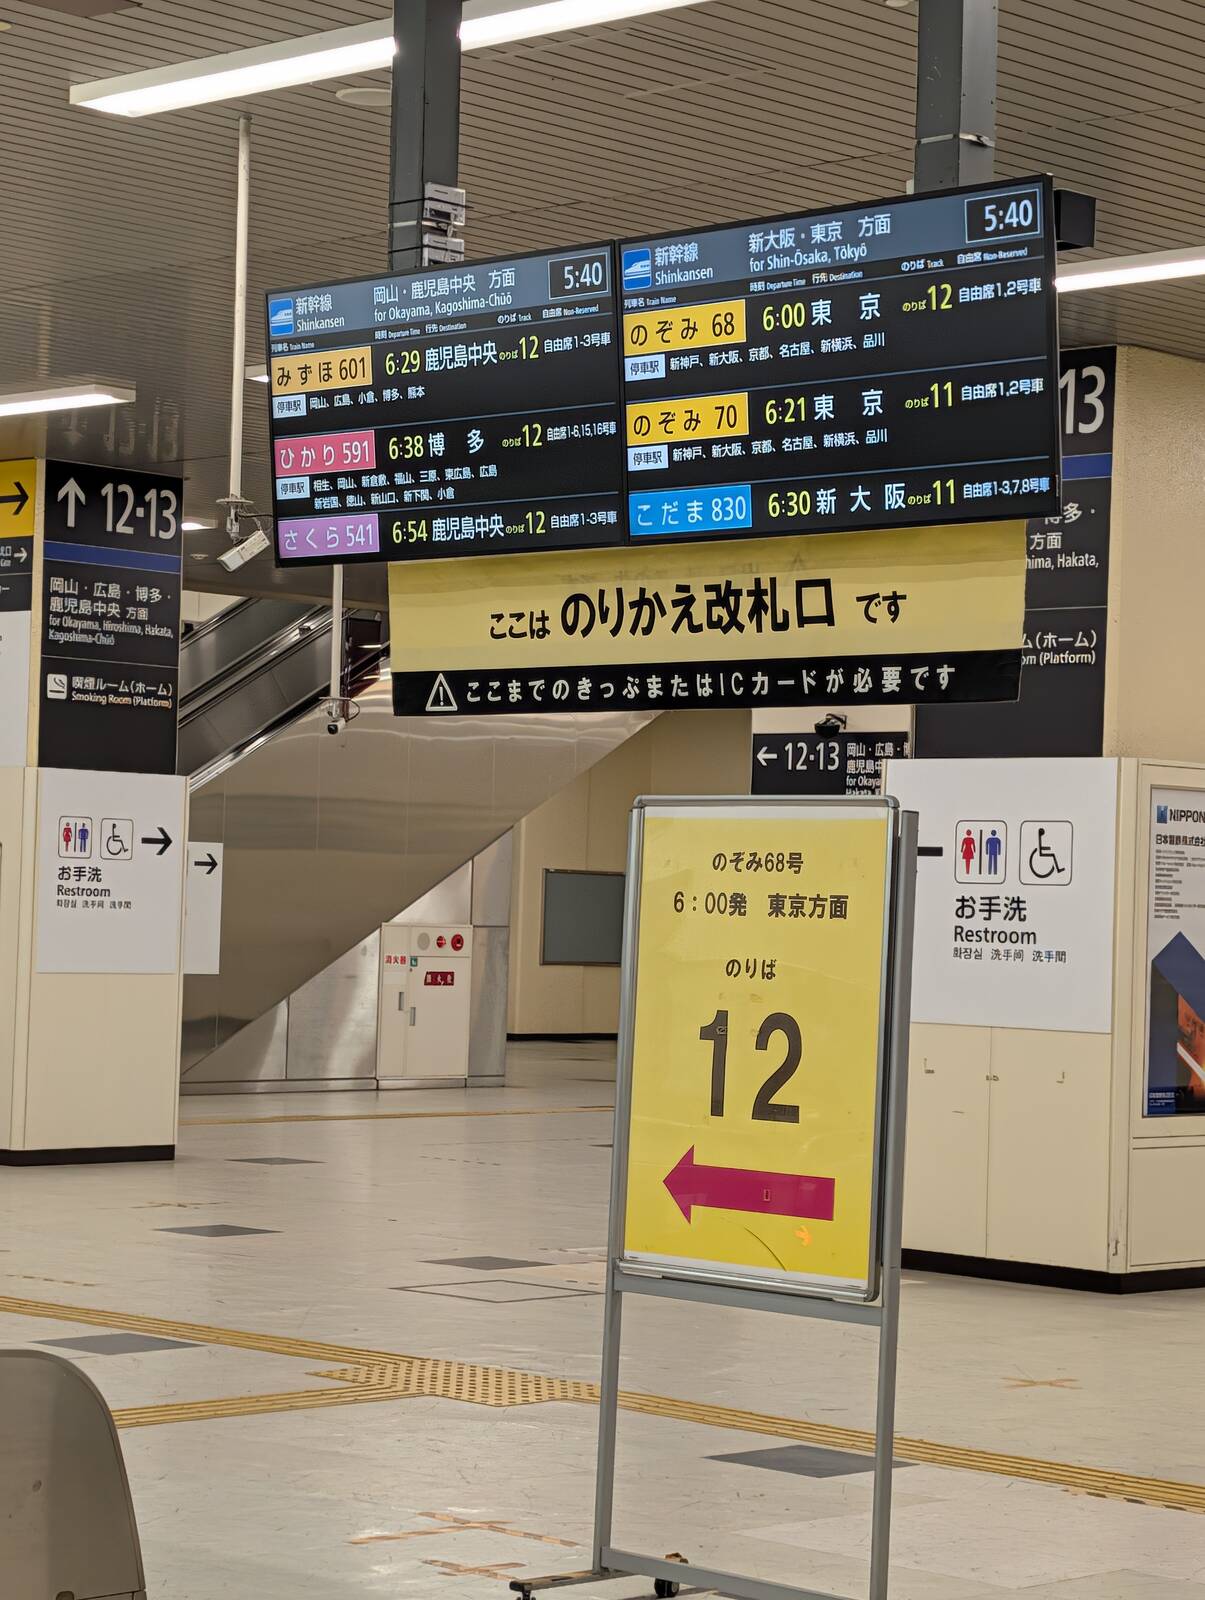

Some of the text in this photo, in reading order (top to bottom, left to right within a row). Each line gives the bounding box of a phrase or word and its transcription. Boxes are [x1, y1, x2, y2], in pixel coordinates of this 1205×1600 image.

[858, 213, 891, 238] 方面
[984, 199, 1033, 232] 5:40
[655, 242, 698, 267] 新幹線
[563, 262, 603, 290] 5:40
[750, 258, 764, 273] for
[812, 272, 828, 284] 行先
[901, 260, 925, 272] のりば
[957, 252, 982, 265] 自由席
[488, 268, 517, 289] 方面
[655, 267, 713, 286] Shinkansen
[296, 294, 332, 315] 新幹線
[374, 308, 386, 322] for
[388, 304, 433, 322] Okayama,
[297, 315, 345, 332] Shinkansen
[497, 312, 517, 324] のりば
[542, 307, 562, 319] 自由席
[712, 312, 735, 338] 68
[762, 302, 806, 331] 6:00
[339, 356, 366, 381] 601
[385, 350, 421, 376] 6:29
[425, 340, 498, 372] 鹿児島中央
[630, 360, 660, 375] 停車駅
[277, 399, 302, 413] 停車駅
[714, 404, 738, 430] 70
[765, 397, 806, 425] 6:21
[342, 440, 369, 464] 591
[388, 435, 424, 460] 6:38
[633, 450, 662, 465] 停車駅
[280, 481, 305, 495] 停車駅
[711, 495, 746, 522] 830
[768, 490, 811, 518] 6:30
[346, 523, 374, 547] 541
[392, 519, 428, 544] 6:54
[432, 513, 505, 542] 鹿児島中央
[1030, 531, 1063, 550] 方面
[1057, 551, 1100, 569] Hakata,
[489, 576, 908, 640] ここは のりかえ改札口 です
[49, 614, 61, 626] for
[1039, 650, 1096, 667] (Platform)
[72, 691, 107, 705] Smoking
[108, 694, 132, 705] Room
[846, 775, 857, 786] for
[712, 851, 804, 875] のぞみ68号
[58, 866, 102, 883] お手洗
[57, 884, 111, 897] Restroom
[767, 893, 848, 920] 東京方面
[955, 895, 1027, 922] お手洗
[954, 925, 1037, 945] Restroom
[725, 957, 777, 982] のりば
[699, 1009, 802, 1125] 12
